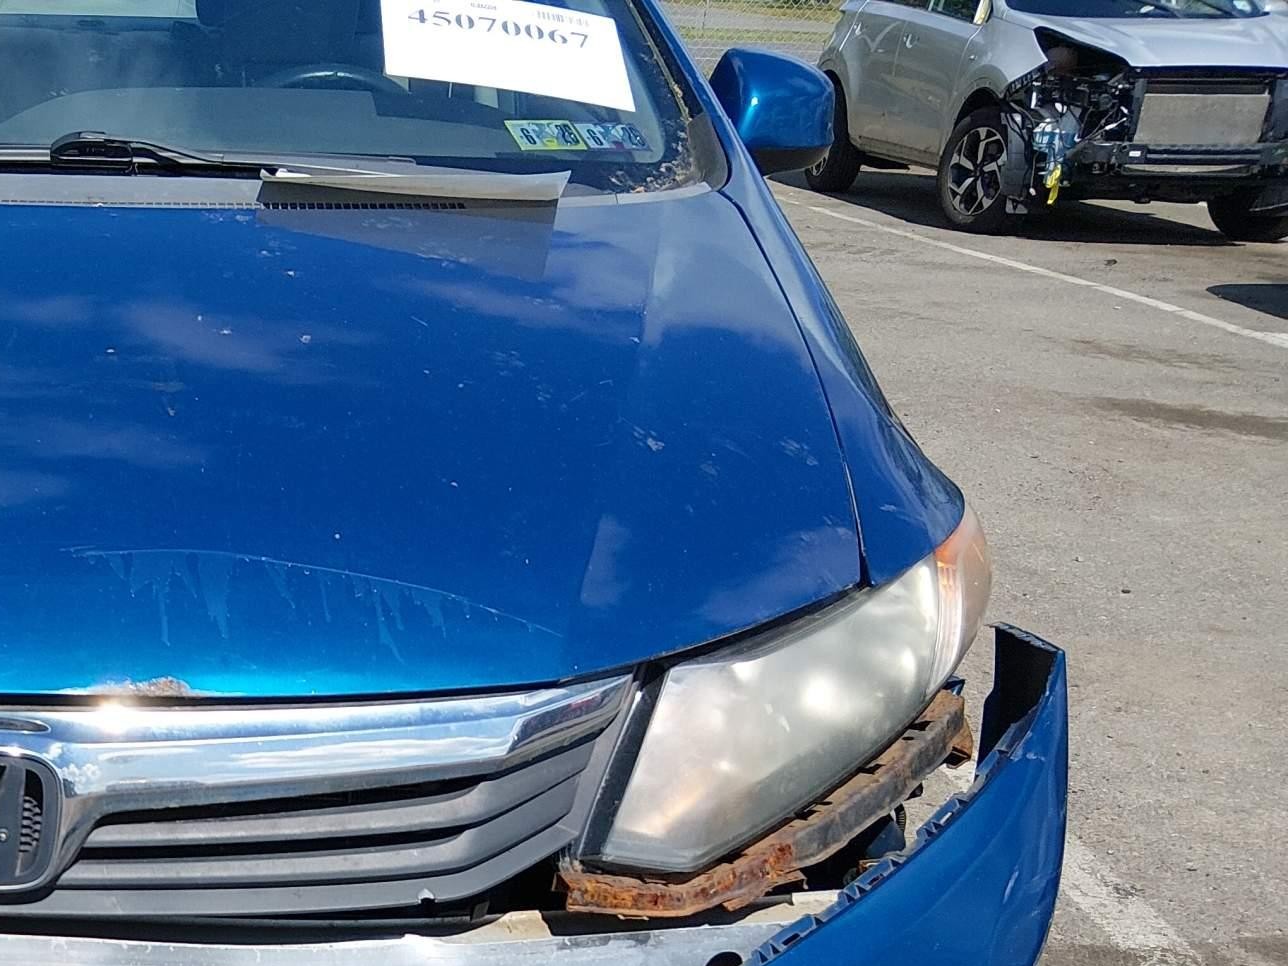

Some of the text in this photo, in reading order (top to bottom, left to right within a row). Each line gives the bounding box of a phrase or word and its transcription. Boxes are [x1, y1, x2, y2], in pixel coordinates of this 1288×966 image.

[408, 8, 589, 49] 45070067
[520, 127, 537, 145] 6
[586, 128, 604, 147] 6
